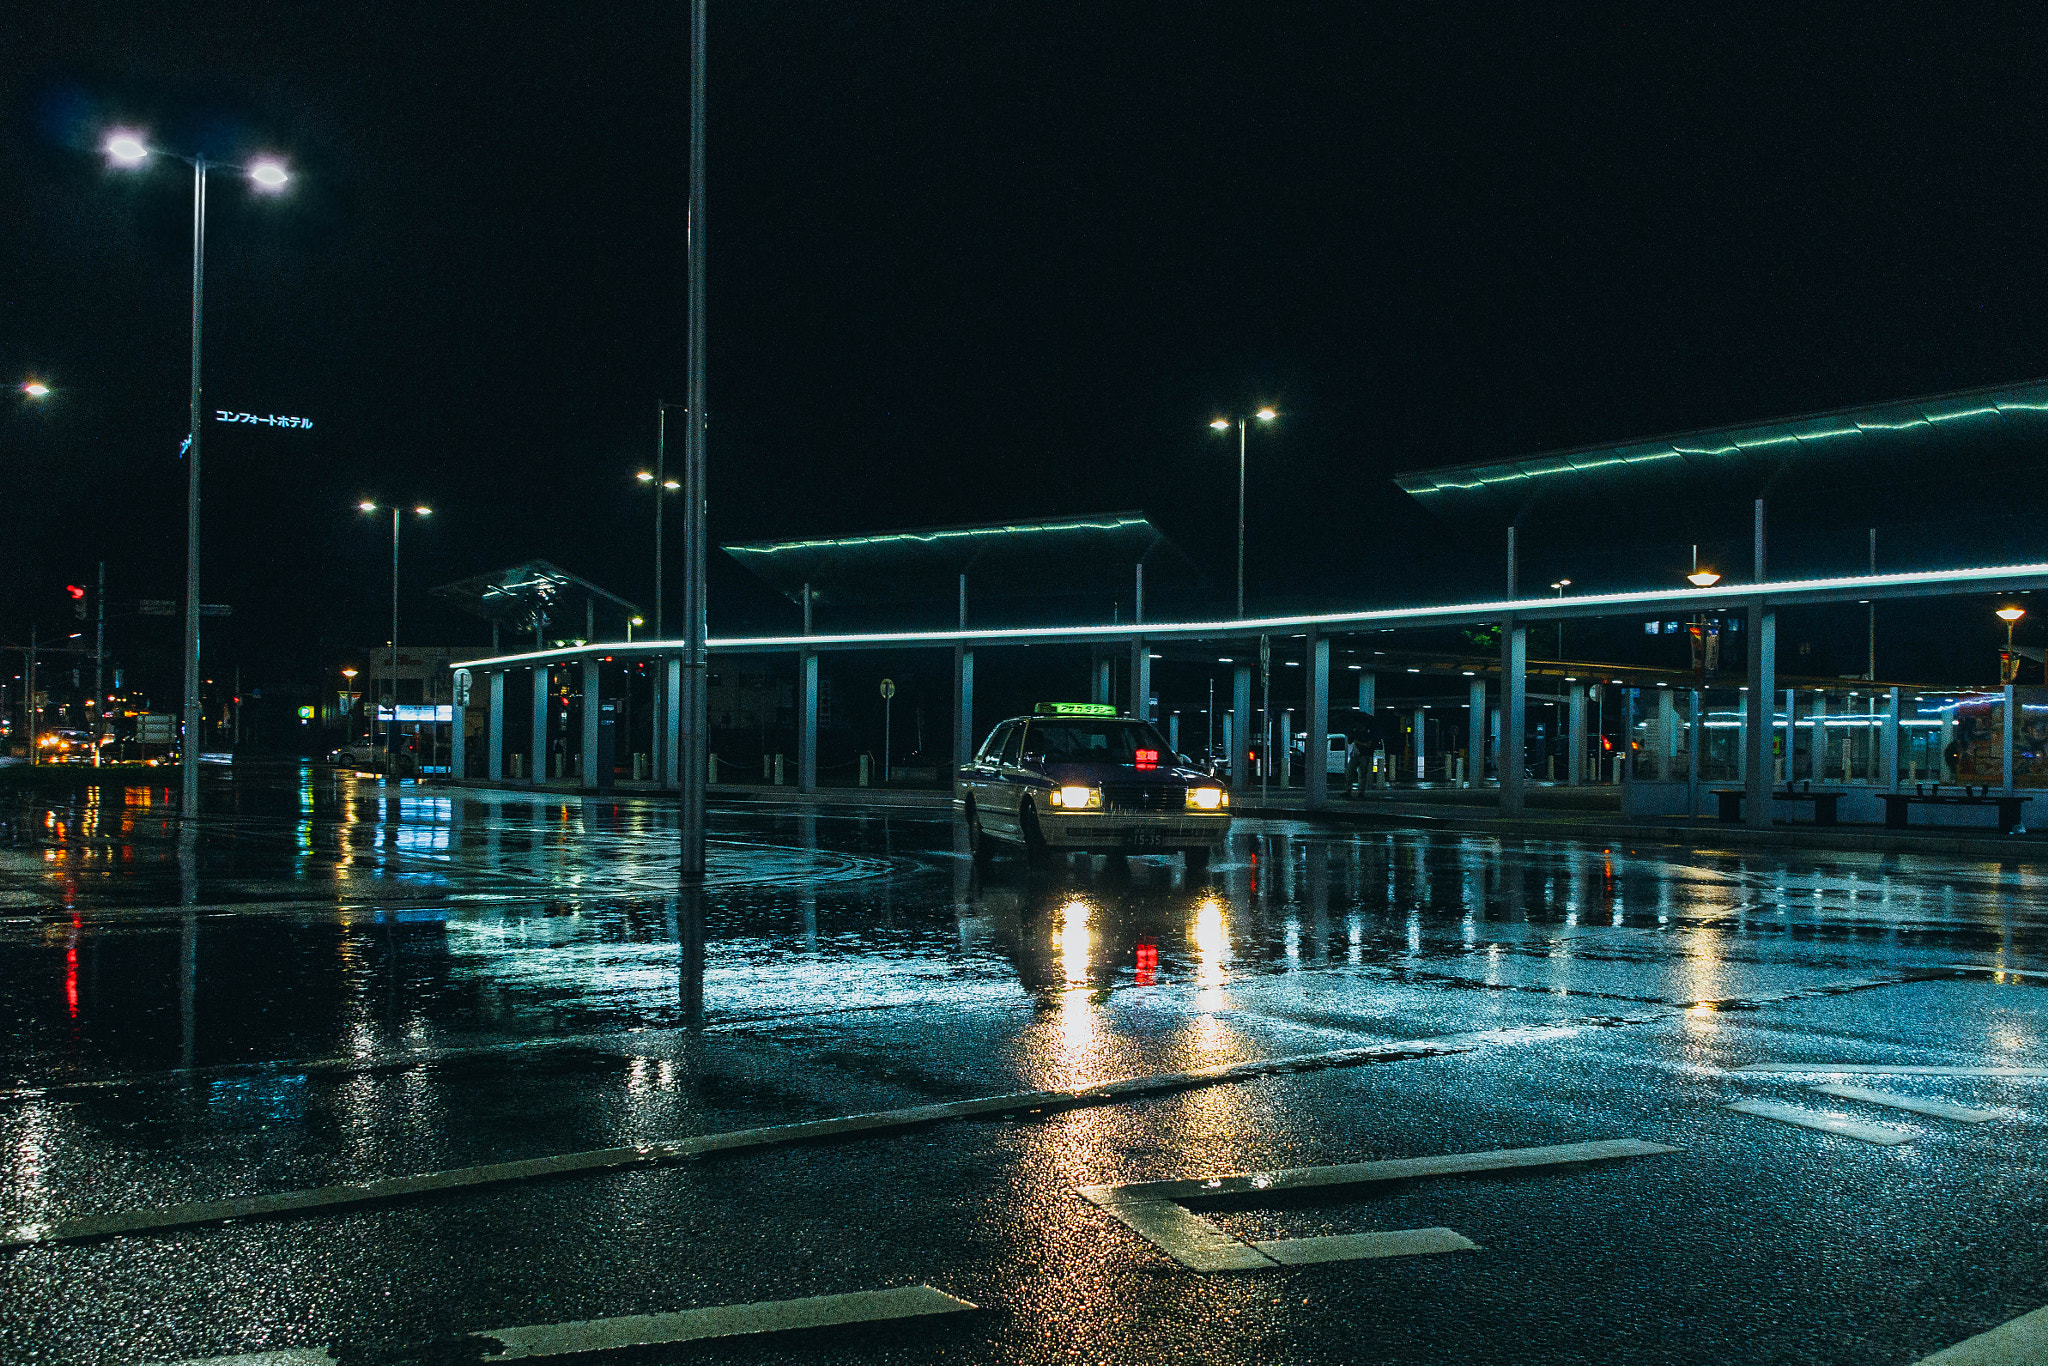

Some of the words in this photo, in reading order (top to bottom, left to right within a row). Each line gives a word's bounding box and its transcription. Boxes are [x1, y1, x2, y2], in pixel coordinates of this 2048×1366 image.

[216, 410, 313, 429] コンフォートホテル
